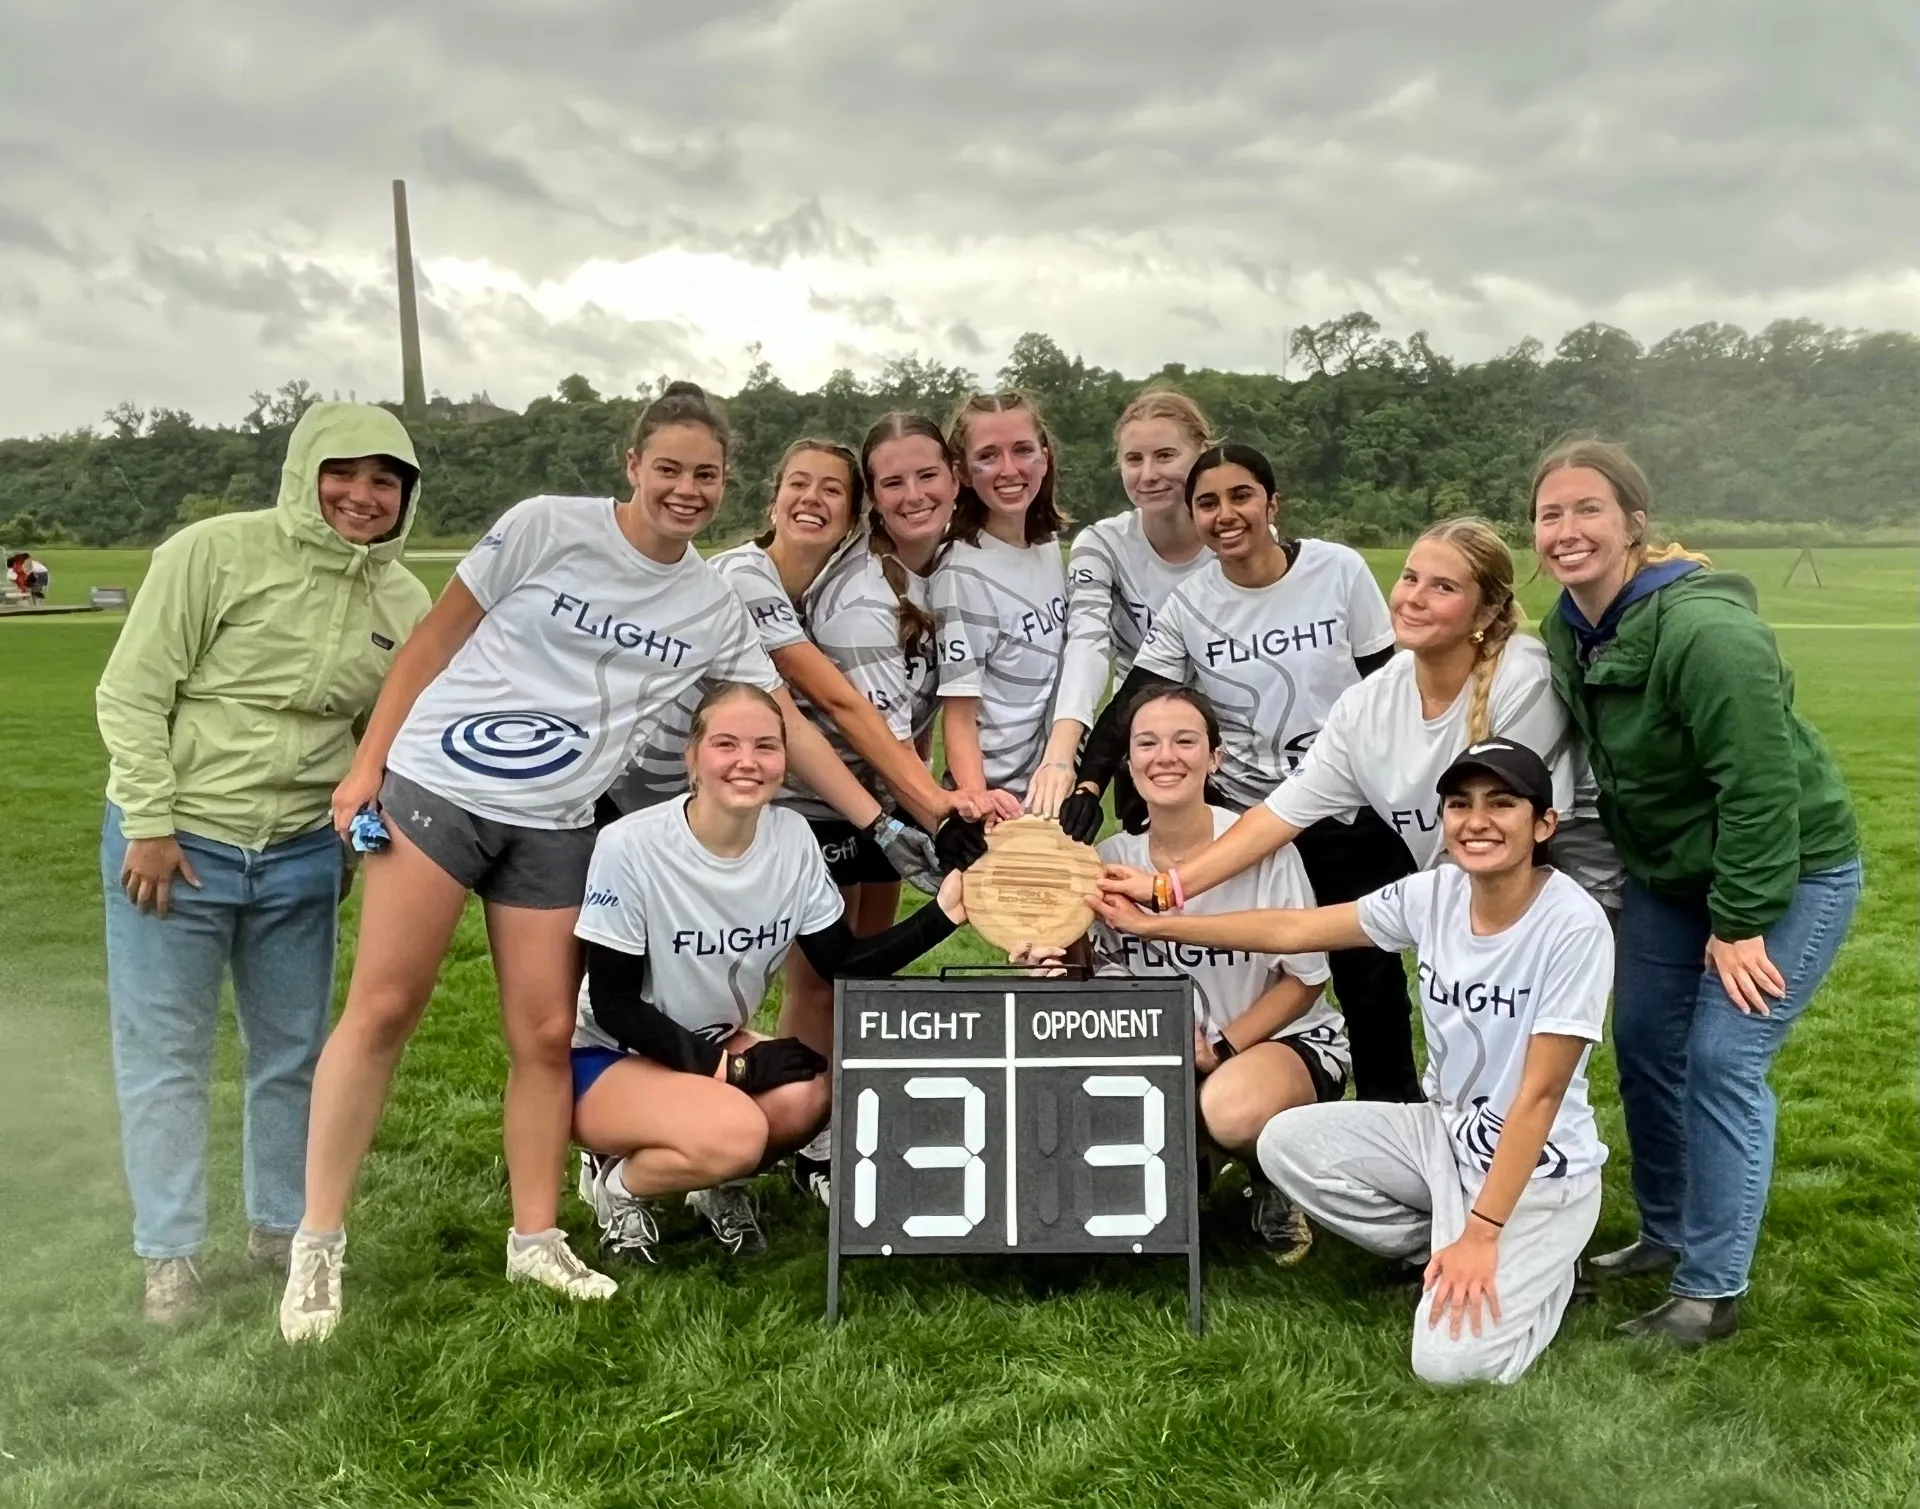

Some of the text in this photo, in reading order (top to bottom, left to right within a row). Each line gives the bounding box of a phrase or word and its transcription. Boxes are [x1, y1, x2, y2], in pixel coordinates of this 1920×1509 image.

[551, 593, 692, 668] FLIGHT
[1206, 618, 1337, 668] FLIGHT
[673, 918, 792, 956] FLIGHT
[860, 1010, 982, 1040] FLIGHT
[1031, 1008, 1163, 1041] OPPONENT
[854, 1076, 986, 1238] 13
[1082, 1075, 1168, 1237] 3
